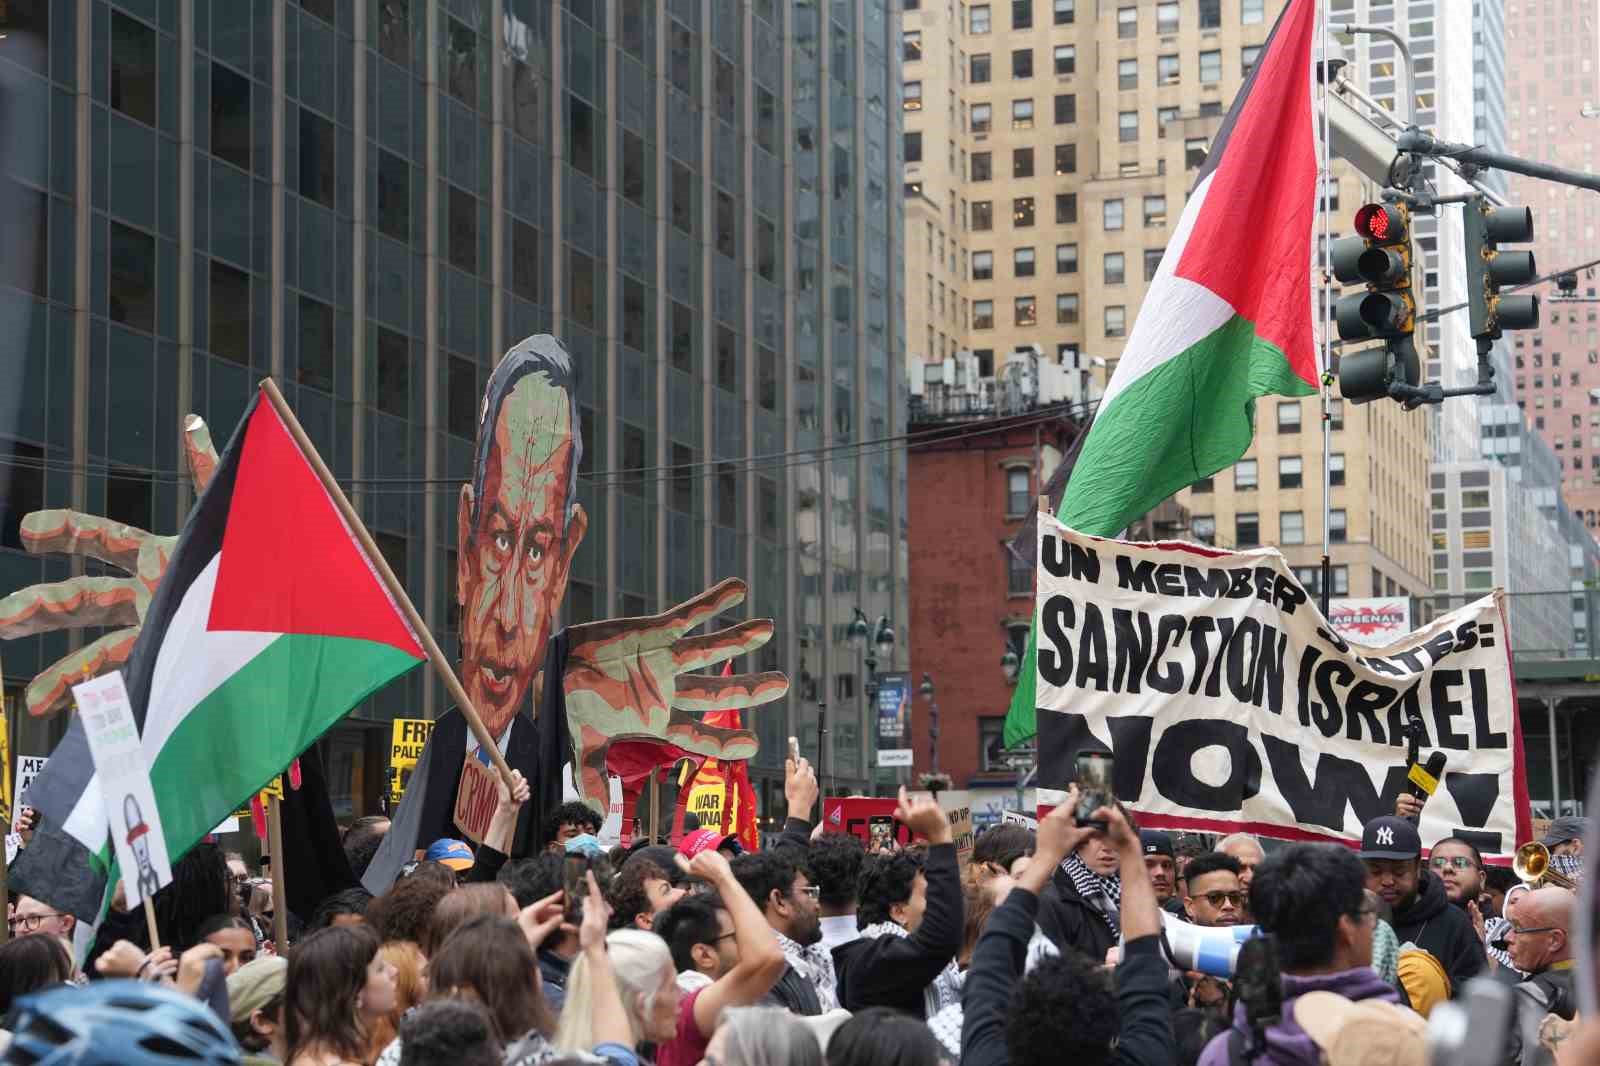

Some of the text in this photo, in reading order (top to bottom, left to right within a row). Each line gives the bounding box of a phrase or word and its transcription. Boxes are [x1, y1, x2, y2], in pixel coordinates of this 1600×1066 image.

[1042, 535, 1100, 584] UN
[1116, 555, 1307, 615] MEMBER
[1037, 595, 1288, 715] SANCTION
[1298, 645, 1508, 750] ISRAEL
[696, 794, 720, 809] WAR
[1037, 708, 1503, 854] NOW!
